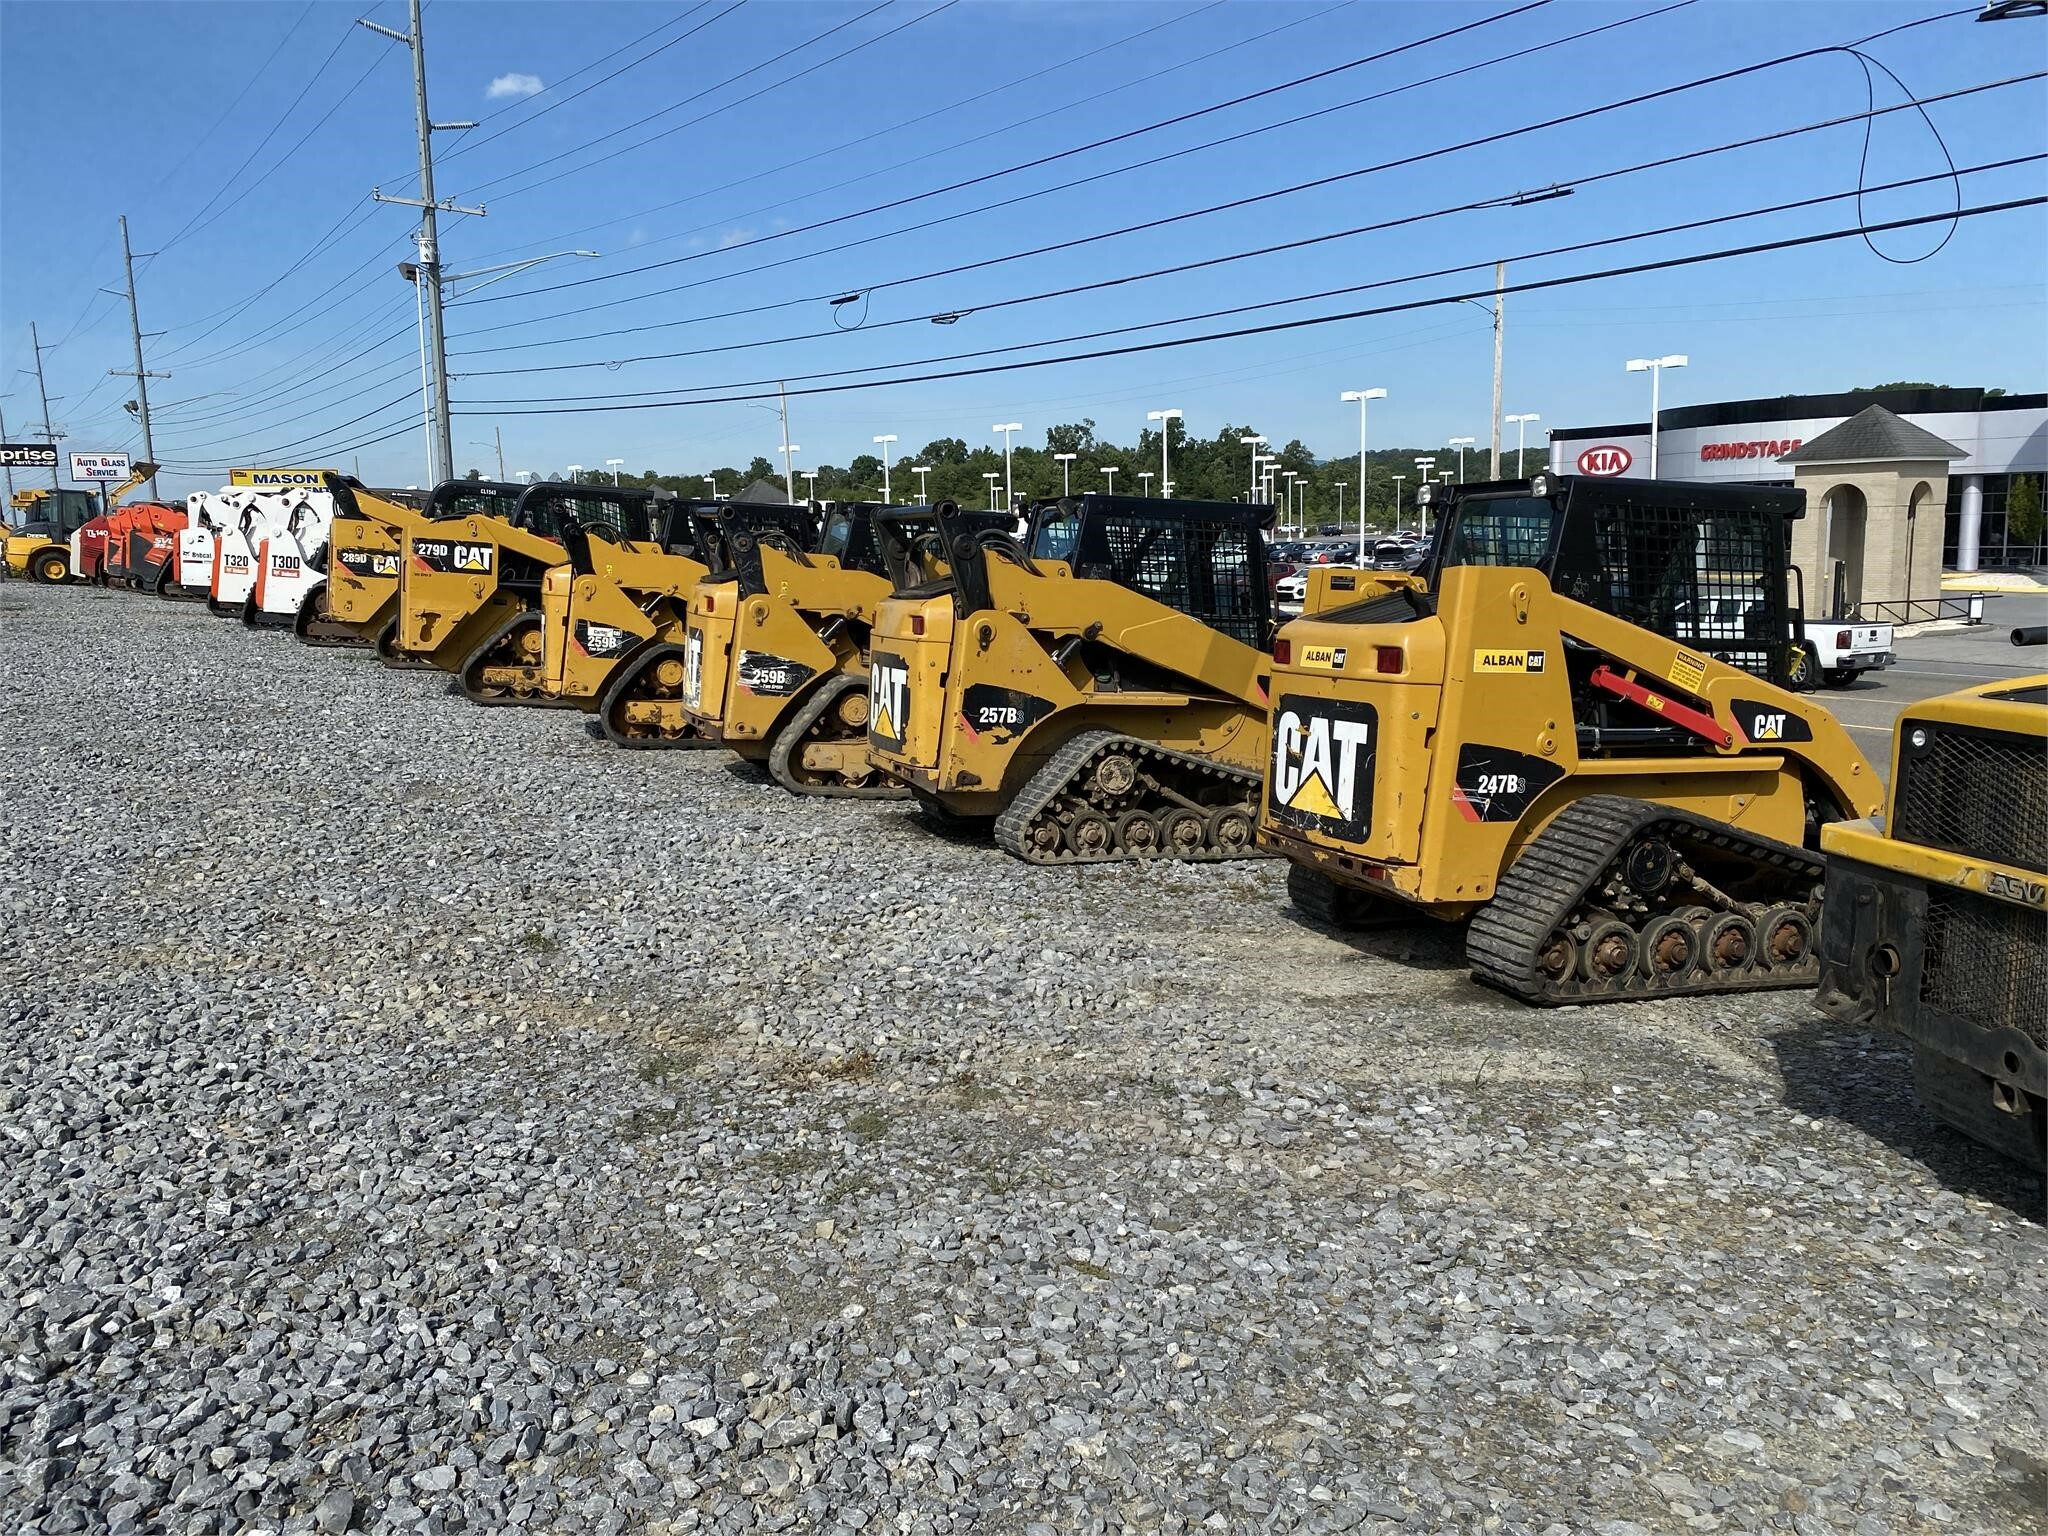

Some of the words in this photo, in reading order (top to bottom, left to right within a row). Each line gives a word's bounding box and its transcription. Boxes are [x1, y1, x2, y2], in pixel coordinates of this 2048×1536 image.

[0, 447, 56, 463] prise
[1701, 439, 1803, 462] GRINDSTAFF
[1587, 452, 1622, 472] KIA
[253, 474, 319, 484] MASON
[224, 554, 249, 566] T320
[272, 555, 300, 569] T300
[342, 553, 367, 563] 289D
[418, 543, 448, 556] 279D
[453, 546, 493, 570] CAT
[1306, 651, 1332, 662] ALBAN
[1333, 652, 1346, 664] CAT
[1482, 655, 1523, 666] ALBAN
[1528, 655, 1543, 666] CAT
[1678, 652, 1705, 671] WARNING
[870, 663, 907, 740] CAT
[1754, 714, 1786, 739] CAT
[1275, 711, 1368, 821] CAT
